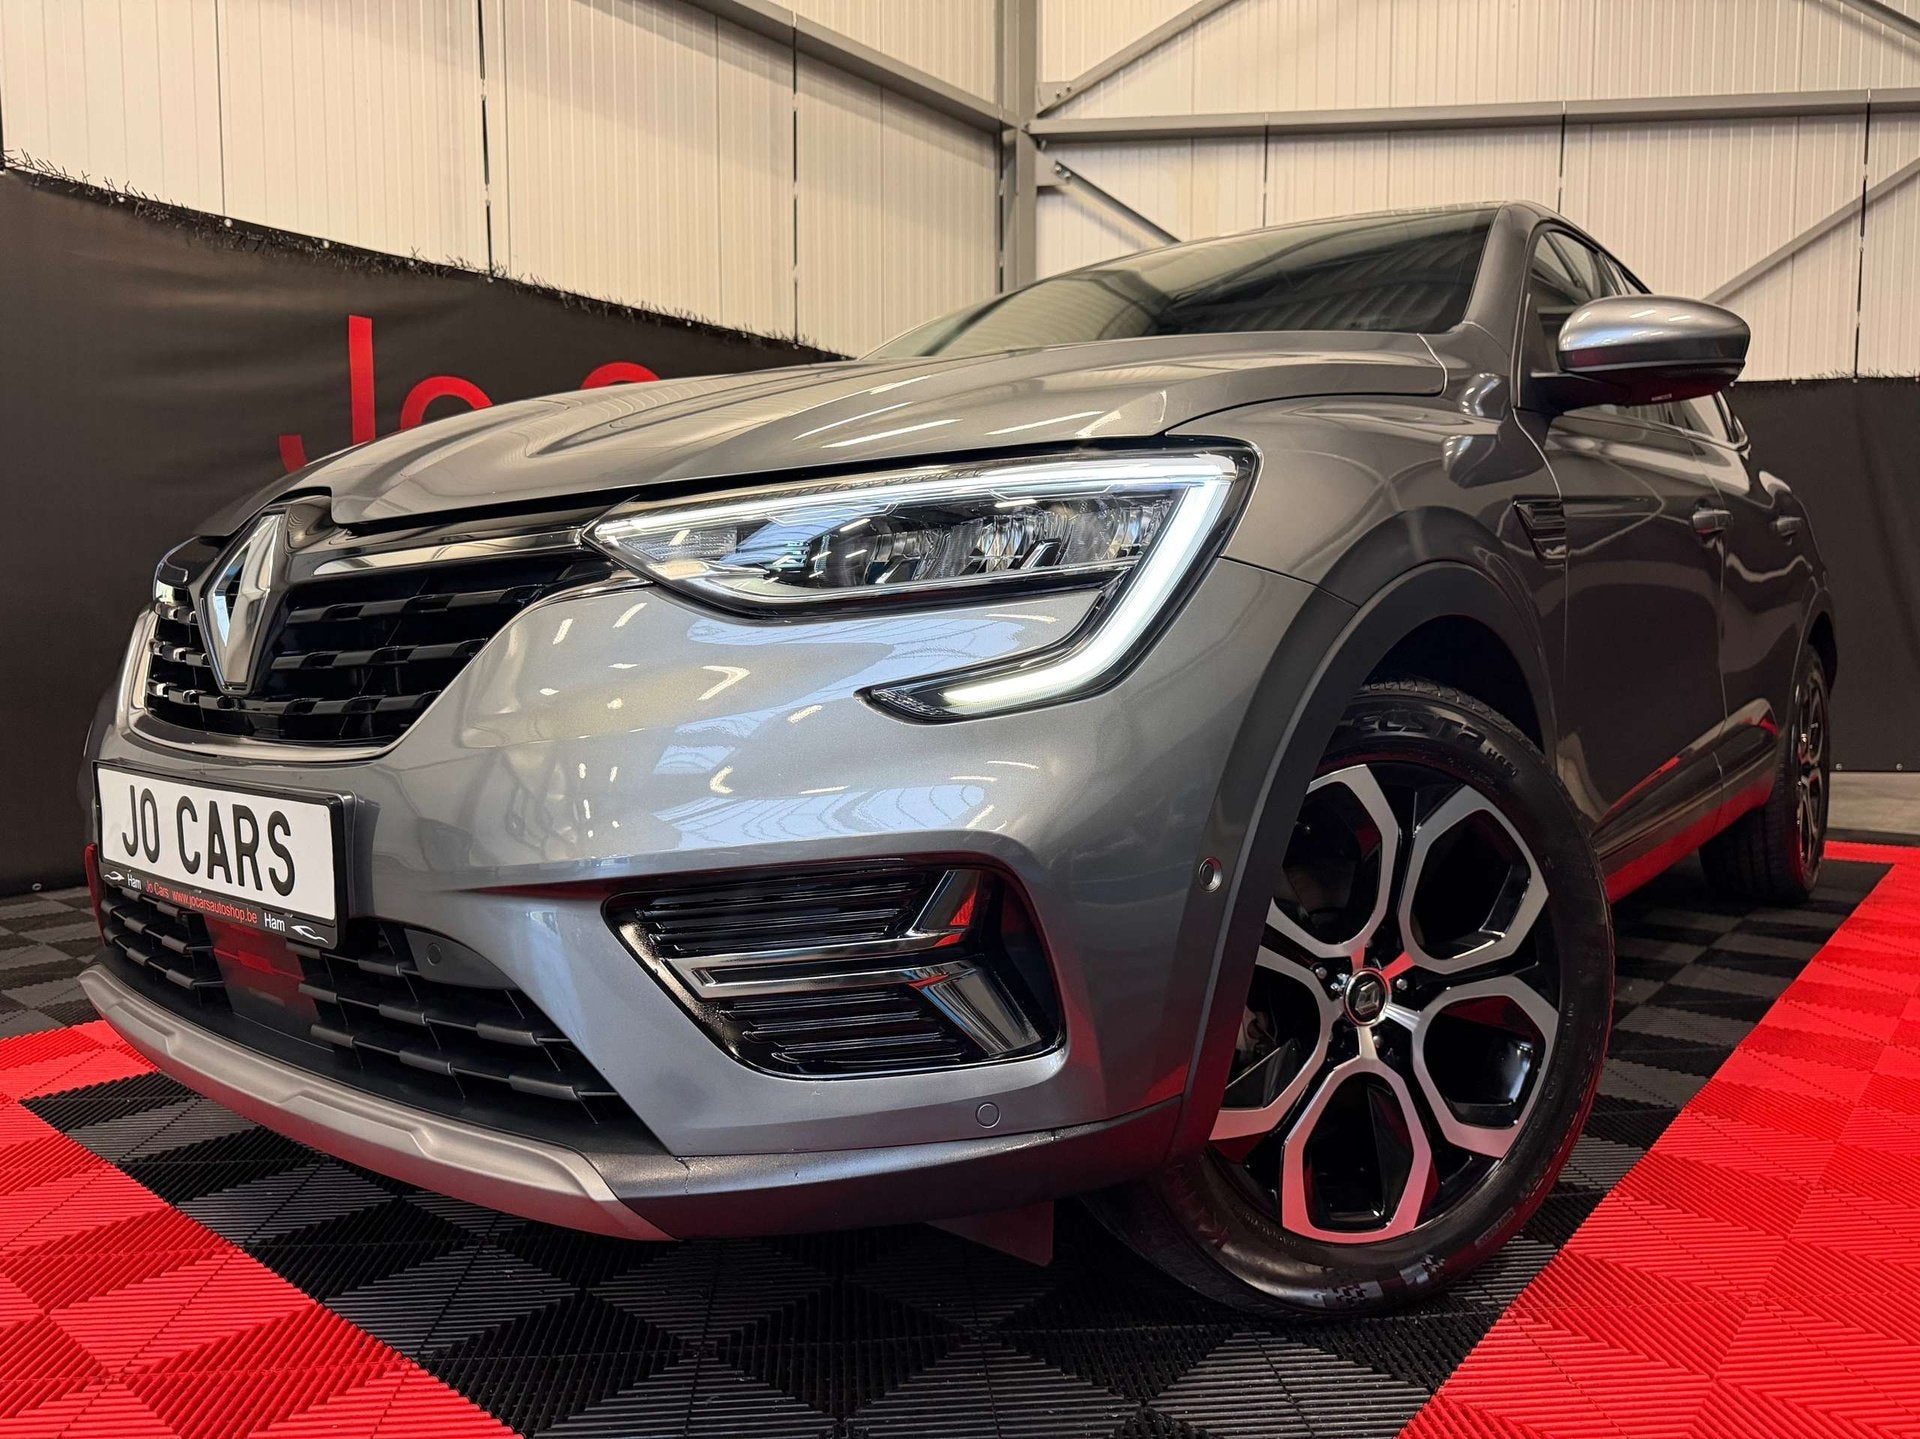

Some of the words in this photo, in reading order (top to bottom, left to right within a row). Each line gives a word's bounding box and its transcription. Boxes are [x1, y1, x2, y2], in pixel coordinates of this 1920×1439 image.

[122, 784, 160, 864] JO
[176, 795, 296, 897] CARS
[127, 873, 142, 891] Ham
[146, 880, 154, 894] Jo
[154, 882, 169, 899] Cars
[172, 890, 258, 924] www.jocarsautoshop.be
[263, 912, 286, 932] Ham
